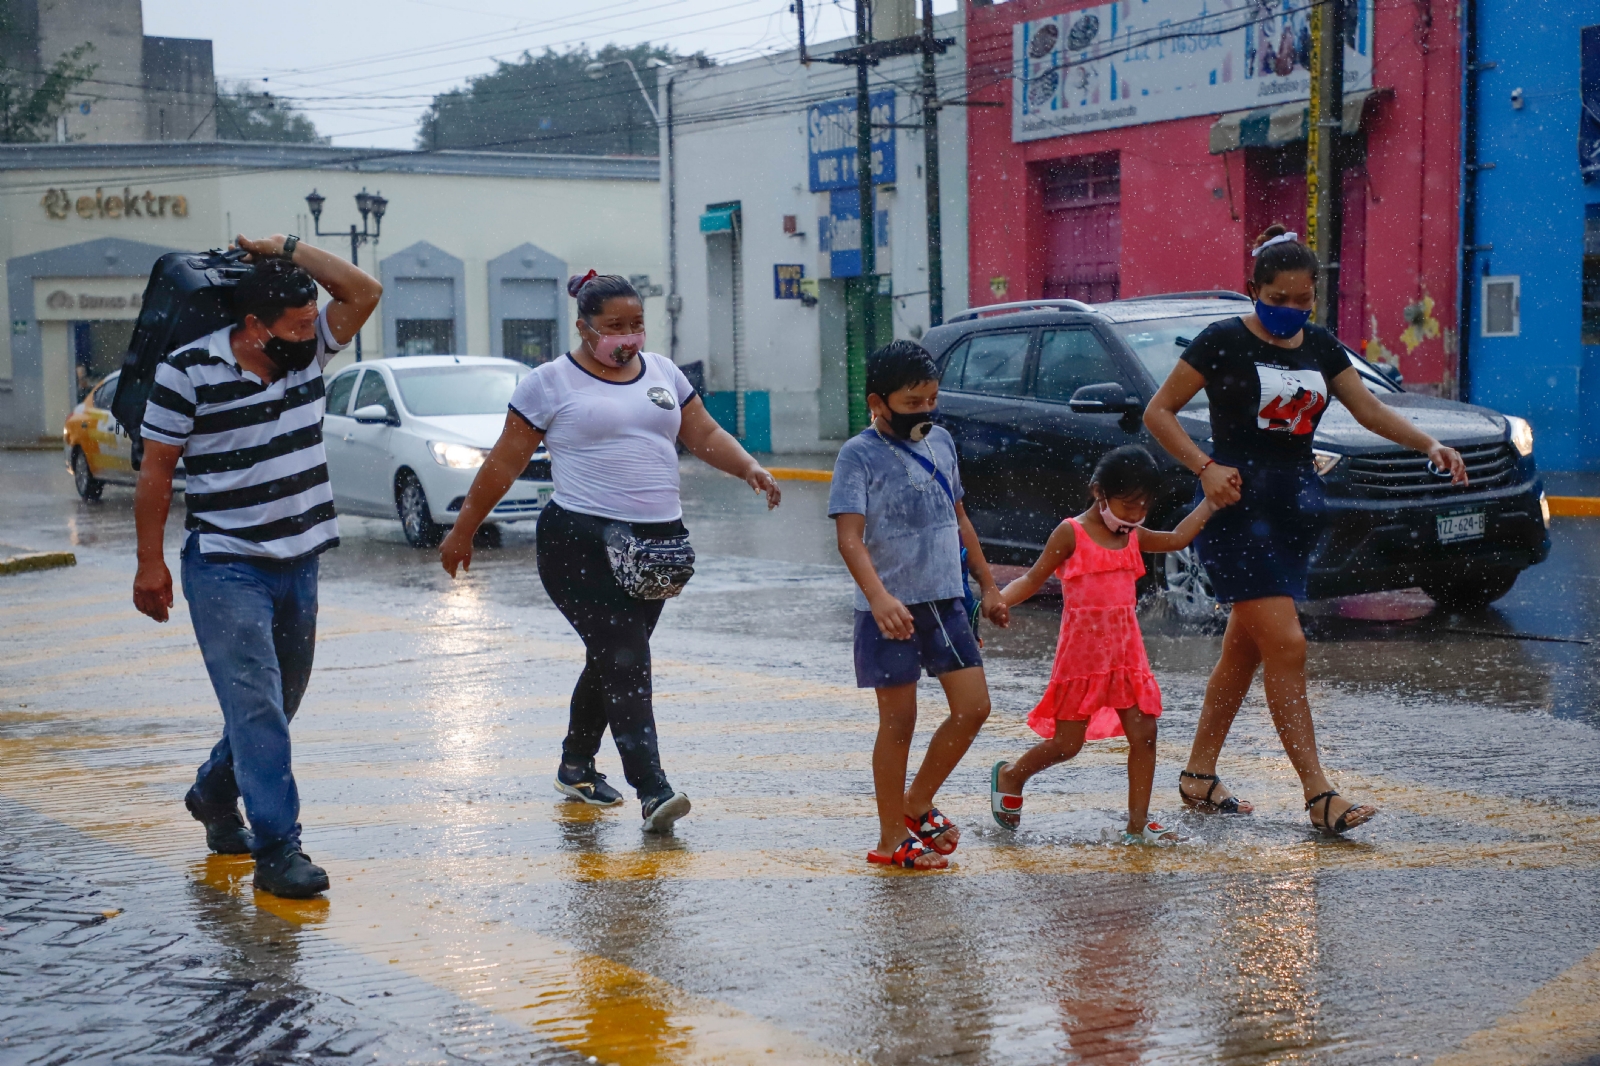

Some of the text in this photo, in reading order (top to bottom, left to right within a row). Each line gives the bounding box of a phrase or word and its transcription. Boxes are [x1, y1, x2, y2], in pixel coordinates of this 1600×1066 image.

[810, 104, 892, 154] Sanitaos
[76, 186, 188, 218] elektra
[777, 265, 801, 279] WC
